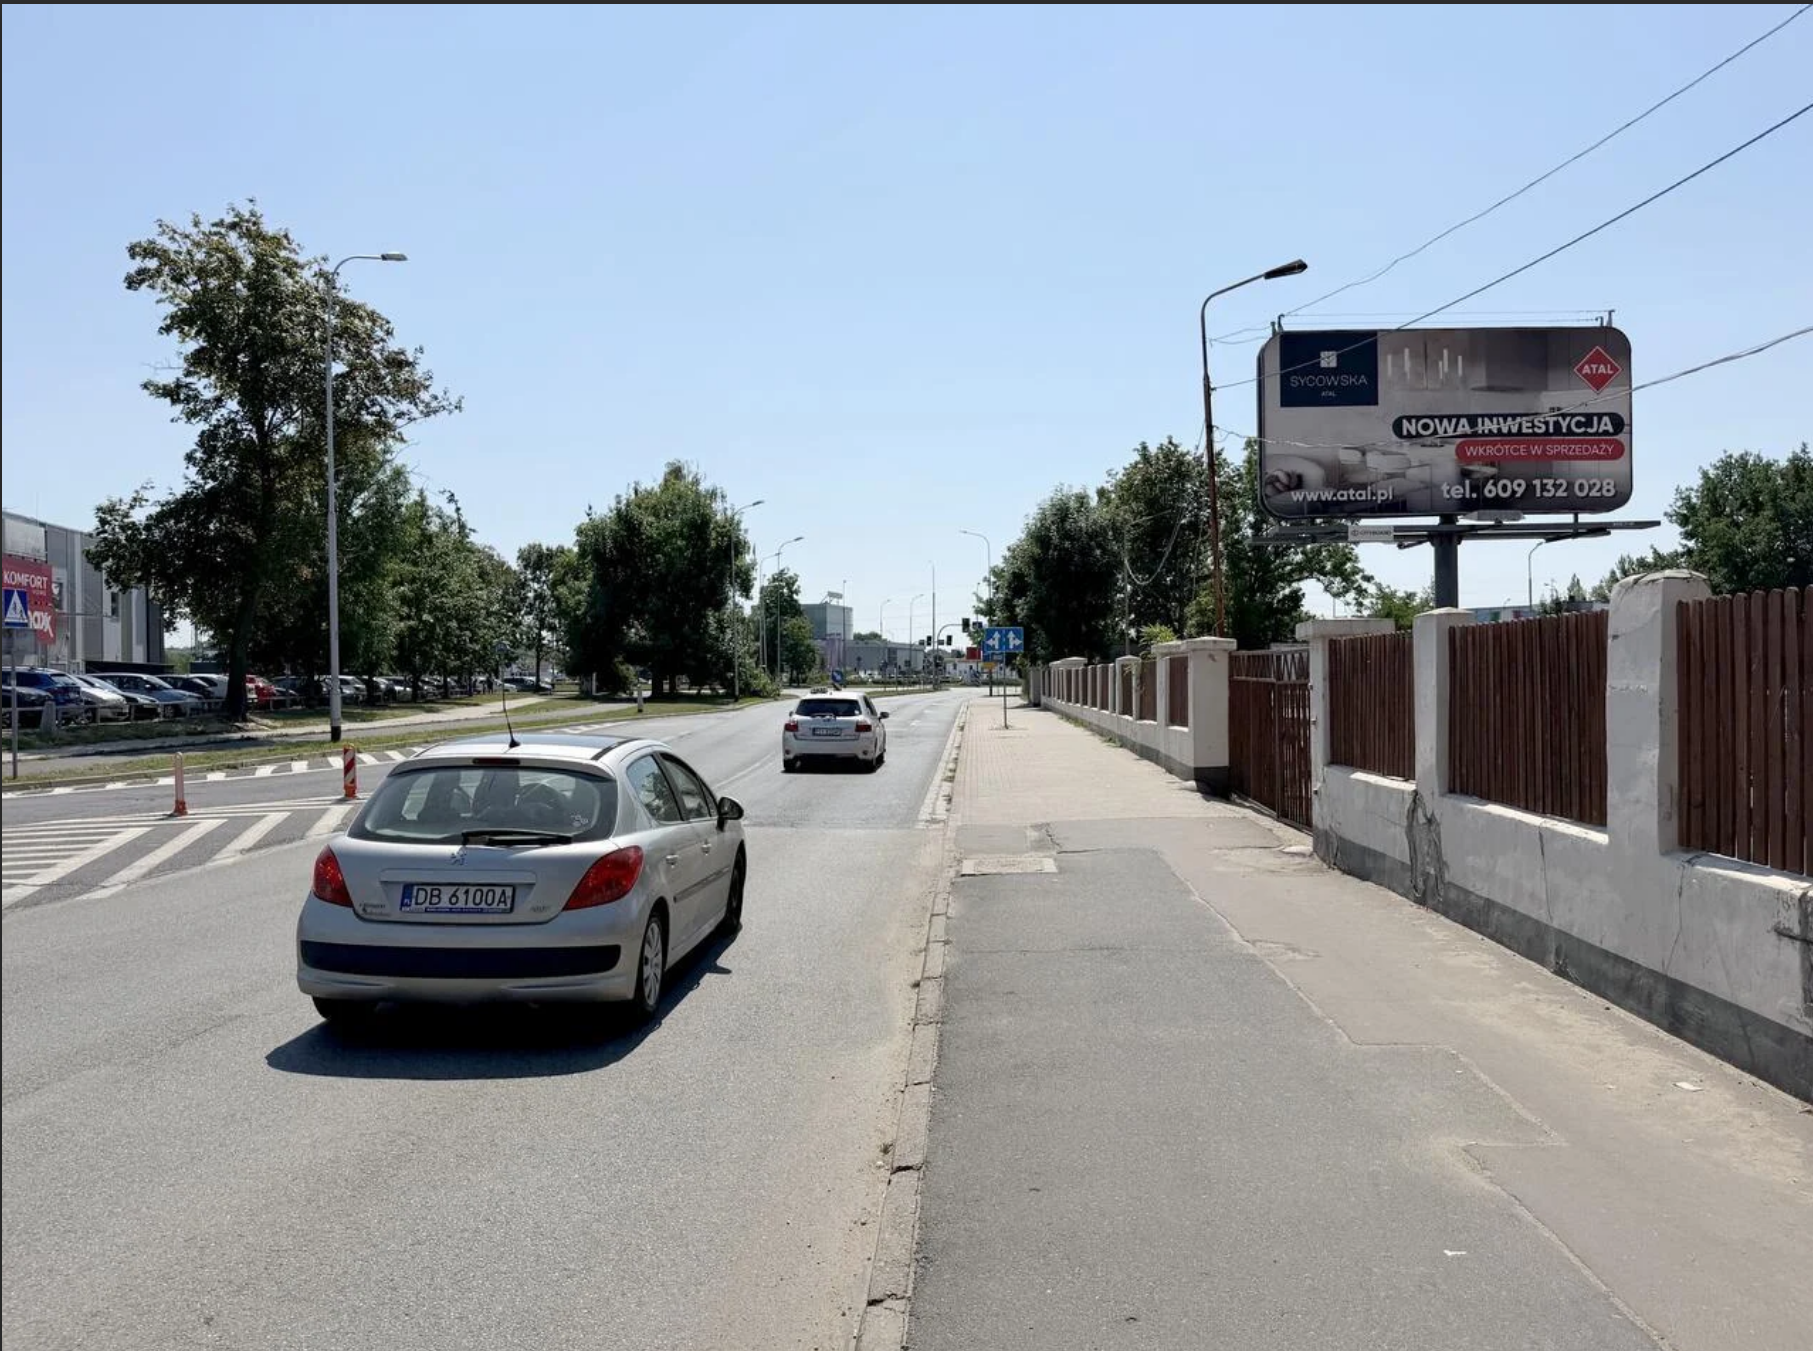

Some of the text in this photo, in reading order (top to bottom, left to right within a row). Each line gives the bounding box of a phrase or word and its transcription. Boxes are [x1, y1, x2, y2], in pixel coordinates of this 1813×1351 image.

[1582, 364, 1614, 374] ATAL
[1289, 374, 1368, 387] SYCOWSKA
[1402, 415, 1614, 436] NOWA INWESTYCJA
[1465, 442, 1614, 456] WKRÓTCE W SPRZEDAŻY
[1291, 486, 1393, 504] www.atal.pl
[1441, 479, 1616, 499] tel. 609 132 028
[3, 571, 48, 590] KOMFORT
[415, 888, 508, 907] DB 6100A
